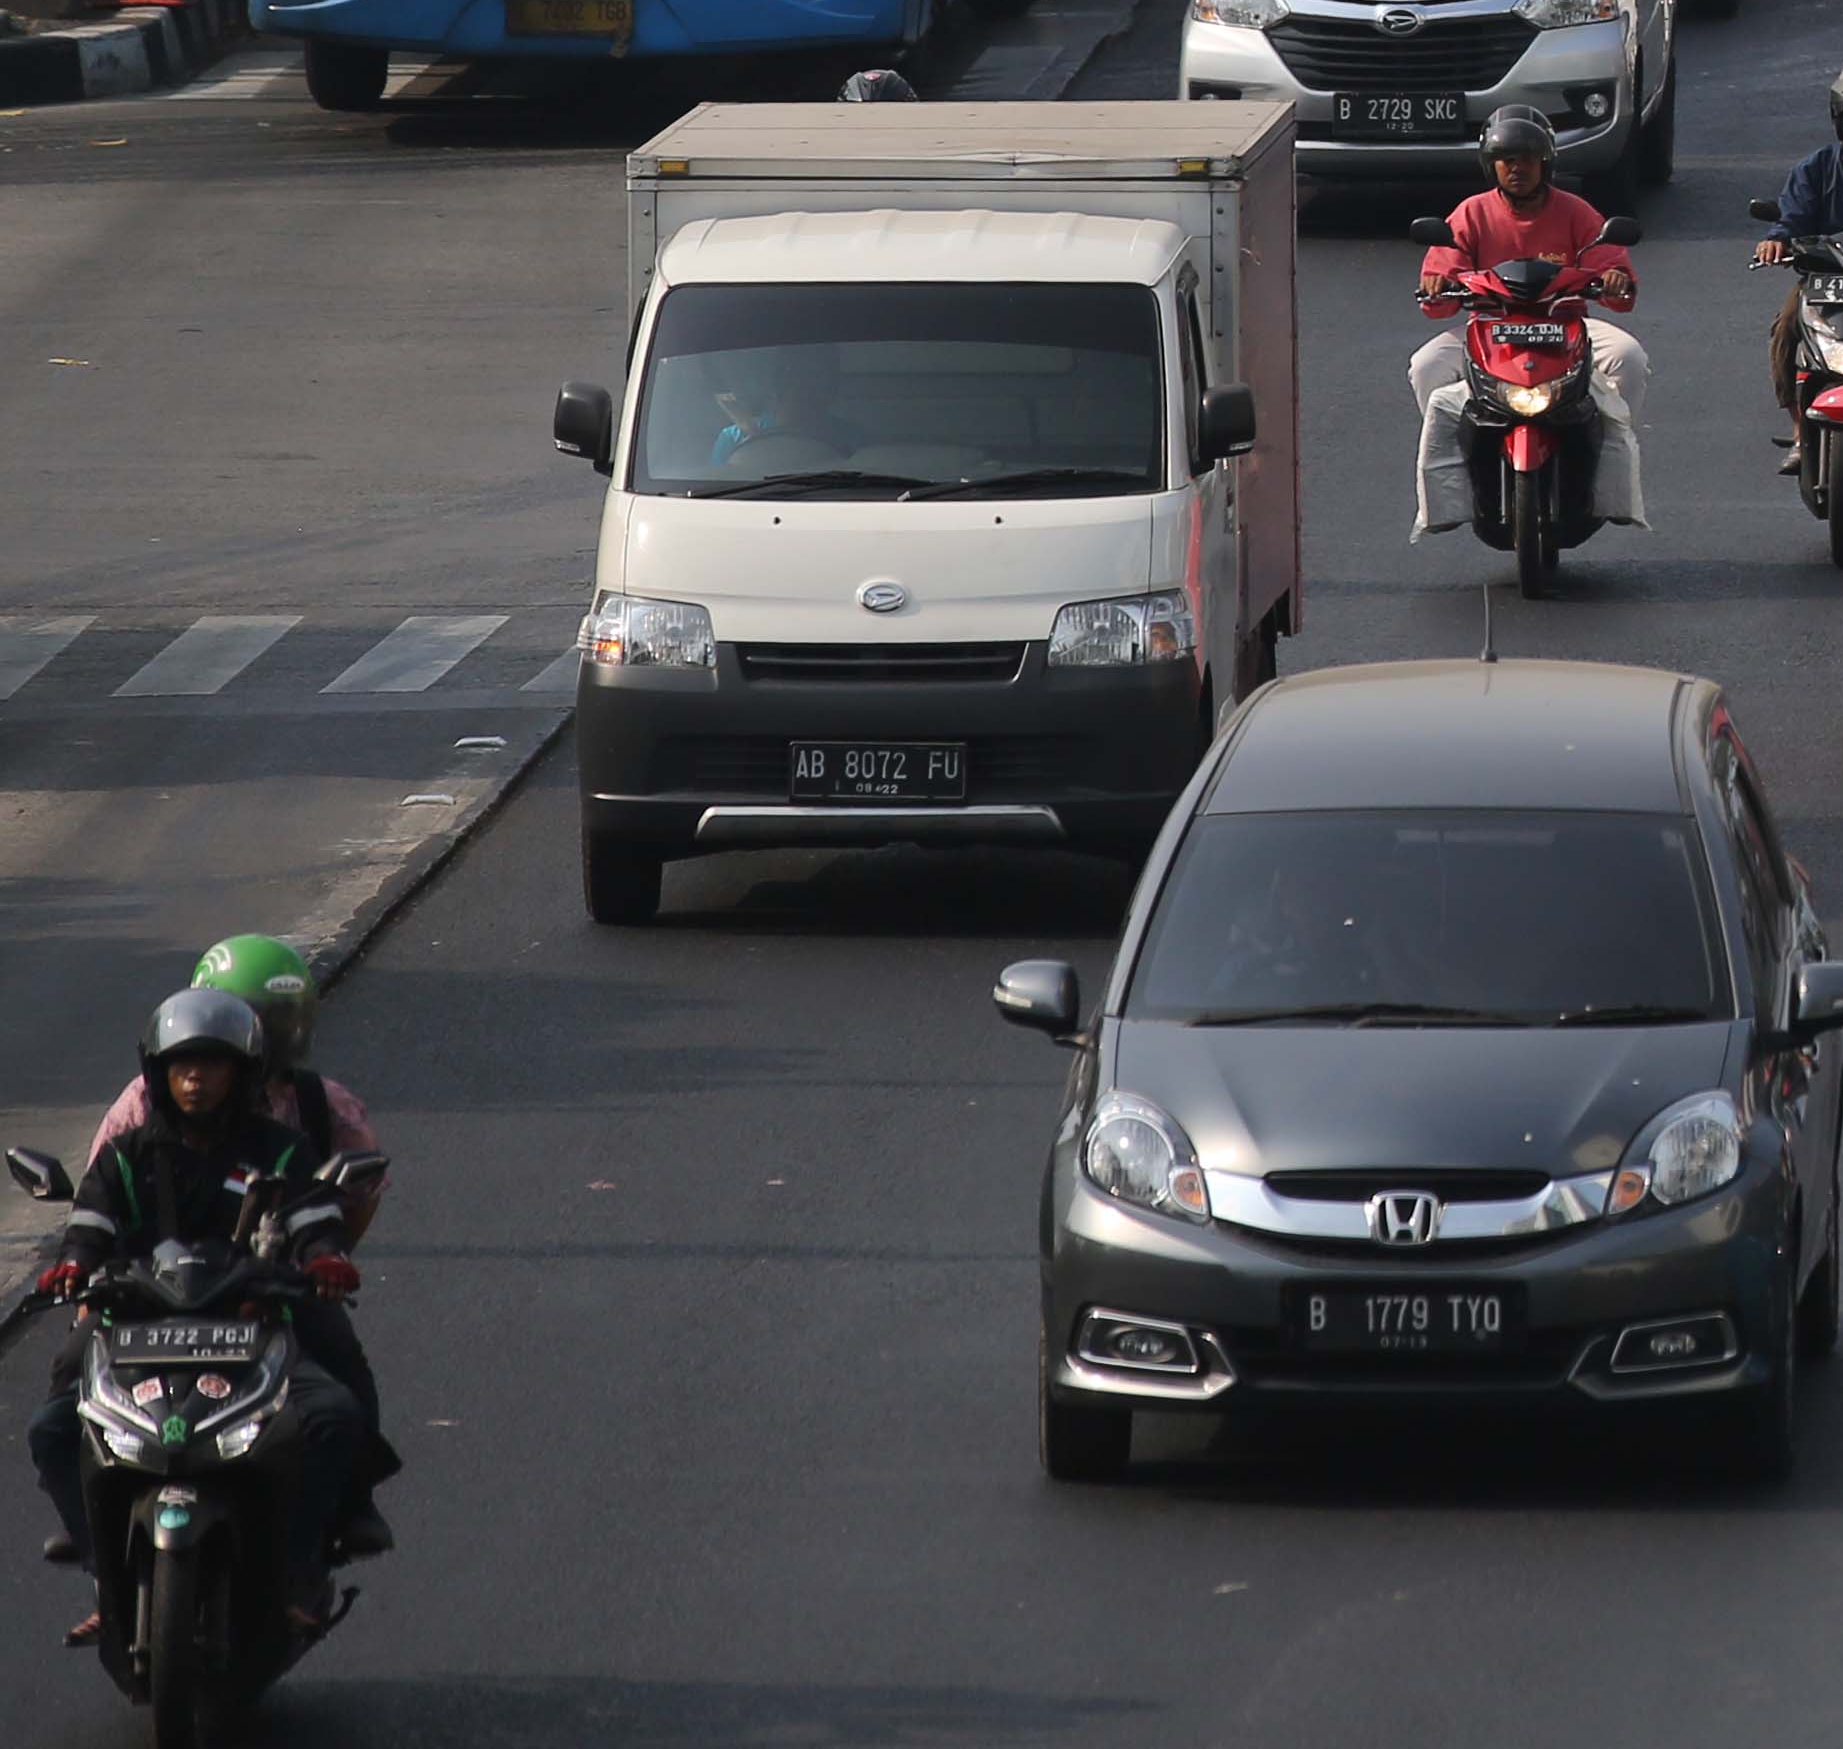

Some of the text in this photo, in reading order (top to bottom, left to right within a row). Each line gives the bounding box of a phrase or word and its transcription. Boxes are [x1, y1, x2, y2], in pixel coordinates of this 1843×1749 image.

[1340, 98, 1457, 120] B 2729 SKC
[1814, 279, 1822, 290] B
[1492, 324, 1500, 335] B
[1503, 325, 1534, 335] 3324
[796, 751, 959, 781] AB 8072 FU
[1310, 1297, 1326, 1331] B
[1365, 1297, 1428, 1331] 1779
[147, 1328, 200, 1345] 3722
